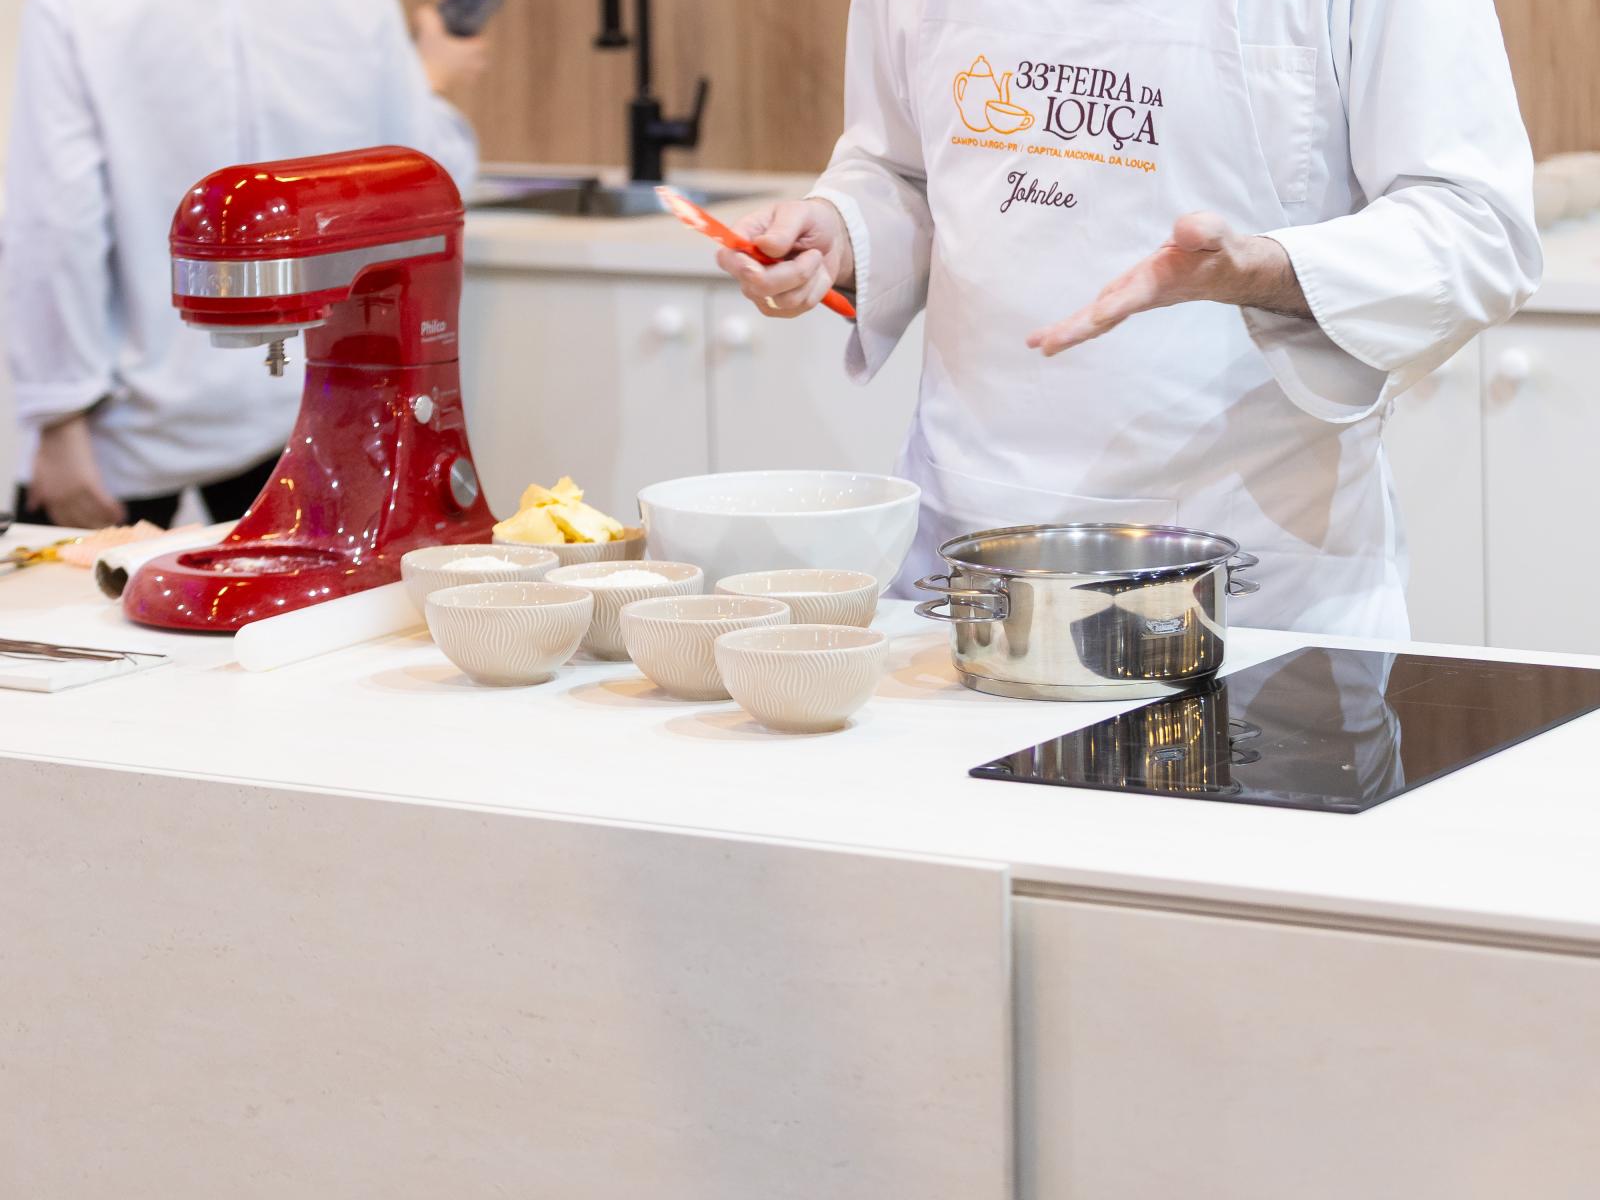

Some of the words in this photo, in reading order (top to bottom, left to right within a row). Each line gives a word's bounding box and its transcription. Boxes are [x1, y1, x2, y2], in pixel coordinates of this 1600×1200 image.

[1054, 64, 1134, 103] FEIRA
[1139, 86, 1163, 107] DA
[1043, 96, 1159, 151] LOUÇA
[951, 136, 979, 147] CAMPO
[1027, 145, 1062, 158] CAPITAL
[1064, 149, 1106, 164] NACIONAL
[1108, 156, 1123, 167] DA
[1125, 158, 1156, 173] LOUÇA
[1000, 171, 1078, 214] Johnlee
[420, 319, 447, 336] Philco
